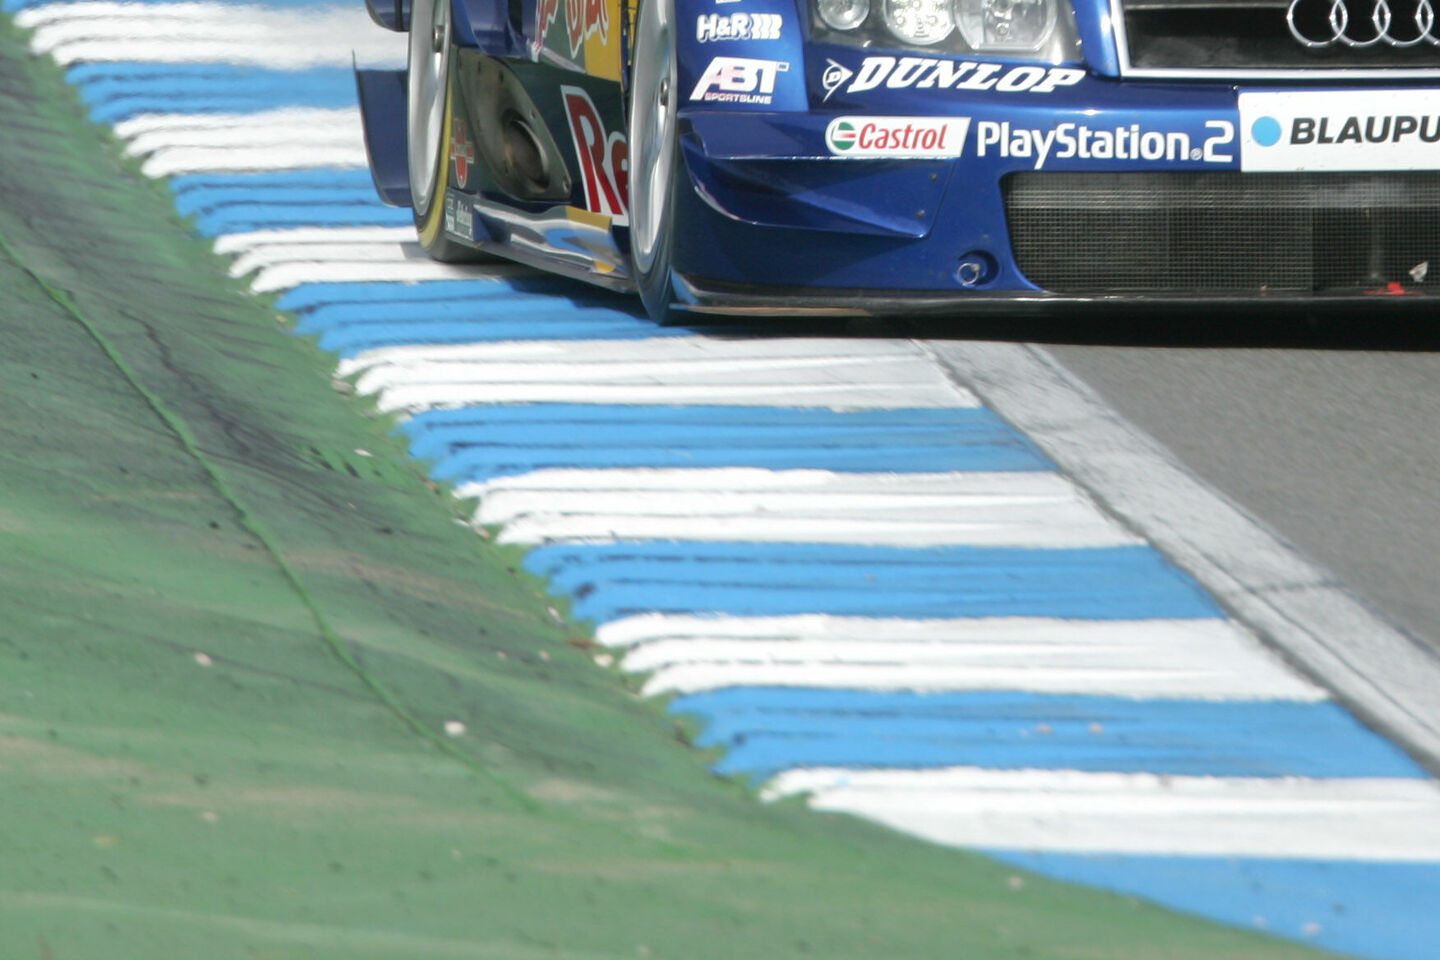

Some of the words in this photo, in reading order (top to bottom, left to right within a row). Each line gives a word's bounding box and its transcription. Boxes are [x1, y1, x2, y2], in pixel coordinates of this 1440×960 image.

[697, 13, 751, 43] H&R
[689, 56, 780, 101] ABT
[847, 56, 1086, 94] DUNLOP
[704, 91, 772, 105] SPORTSLINE
[859, 123, 948, 150] Castrol
